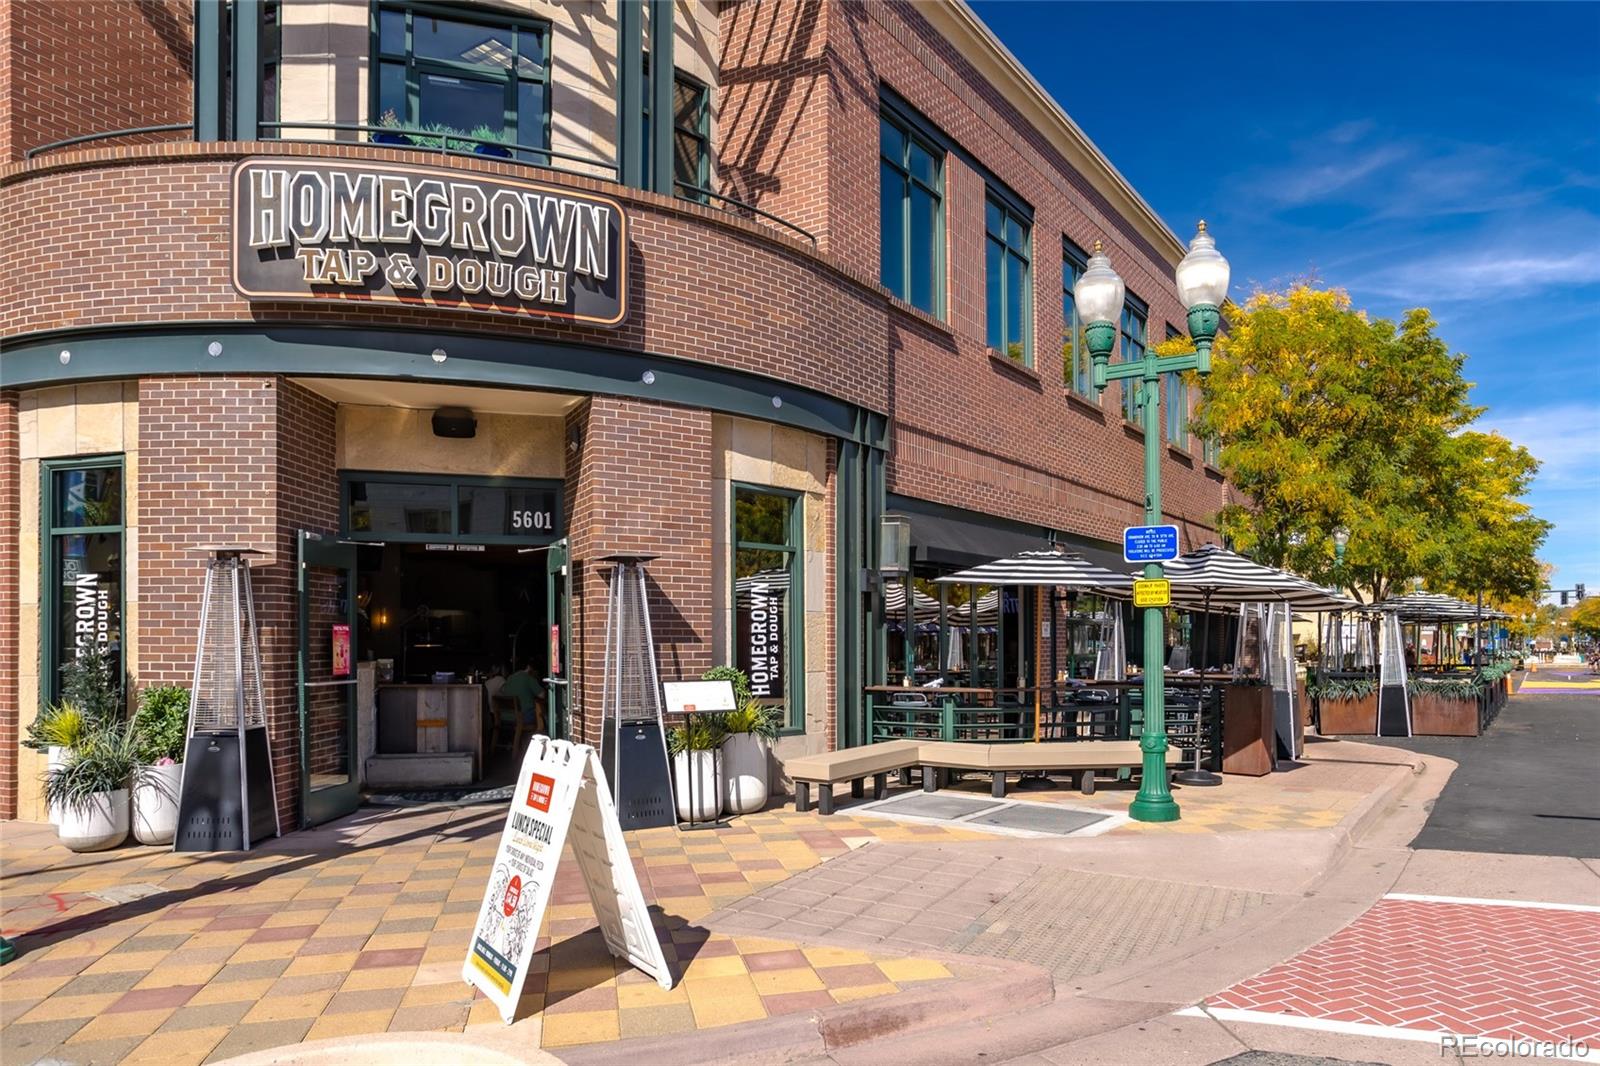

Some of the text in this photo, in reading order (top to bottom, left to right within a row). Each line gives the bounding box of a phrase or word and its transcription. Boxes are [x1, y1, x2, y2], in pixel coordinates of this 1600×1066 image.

[248, 168, 610, 280] HOMEGROWN
[295, 247, 568, 306] TAP & DOUGH
[512, 510, 552, 530] 5601
[76, 573, 98, 671] EGROWN
[98, 590, 108, 641] DOUGH
[750, 581, 771, 696] HOMEGROWN
[769, 596, 778, 680] TAP & DOUGH
[512, 811, 532, 834] LUNCH
[530, 818, 553, 845] SPECIAL
